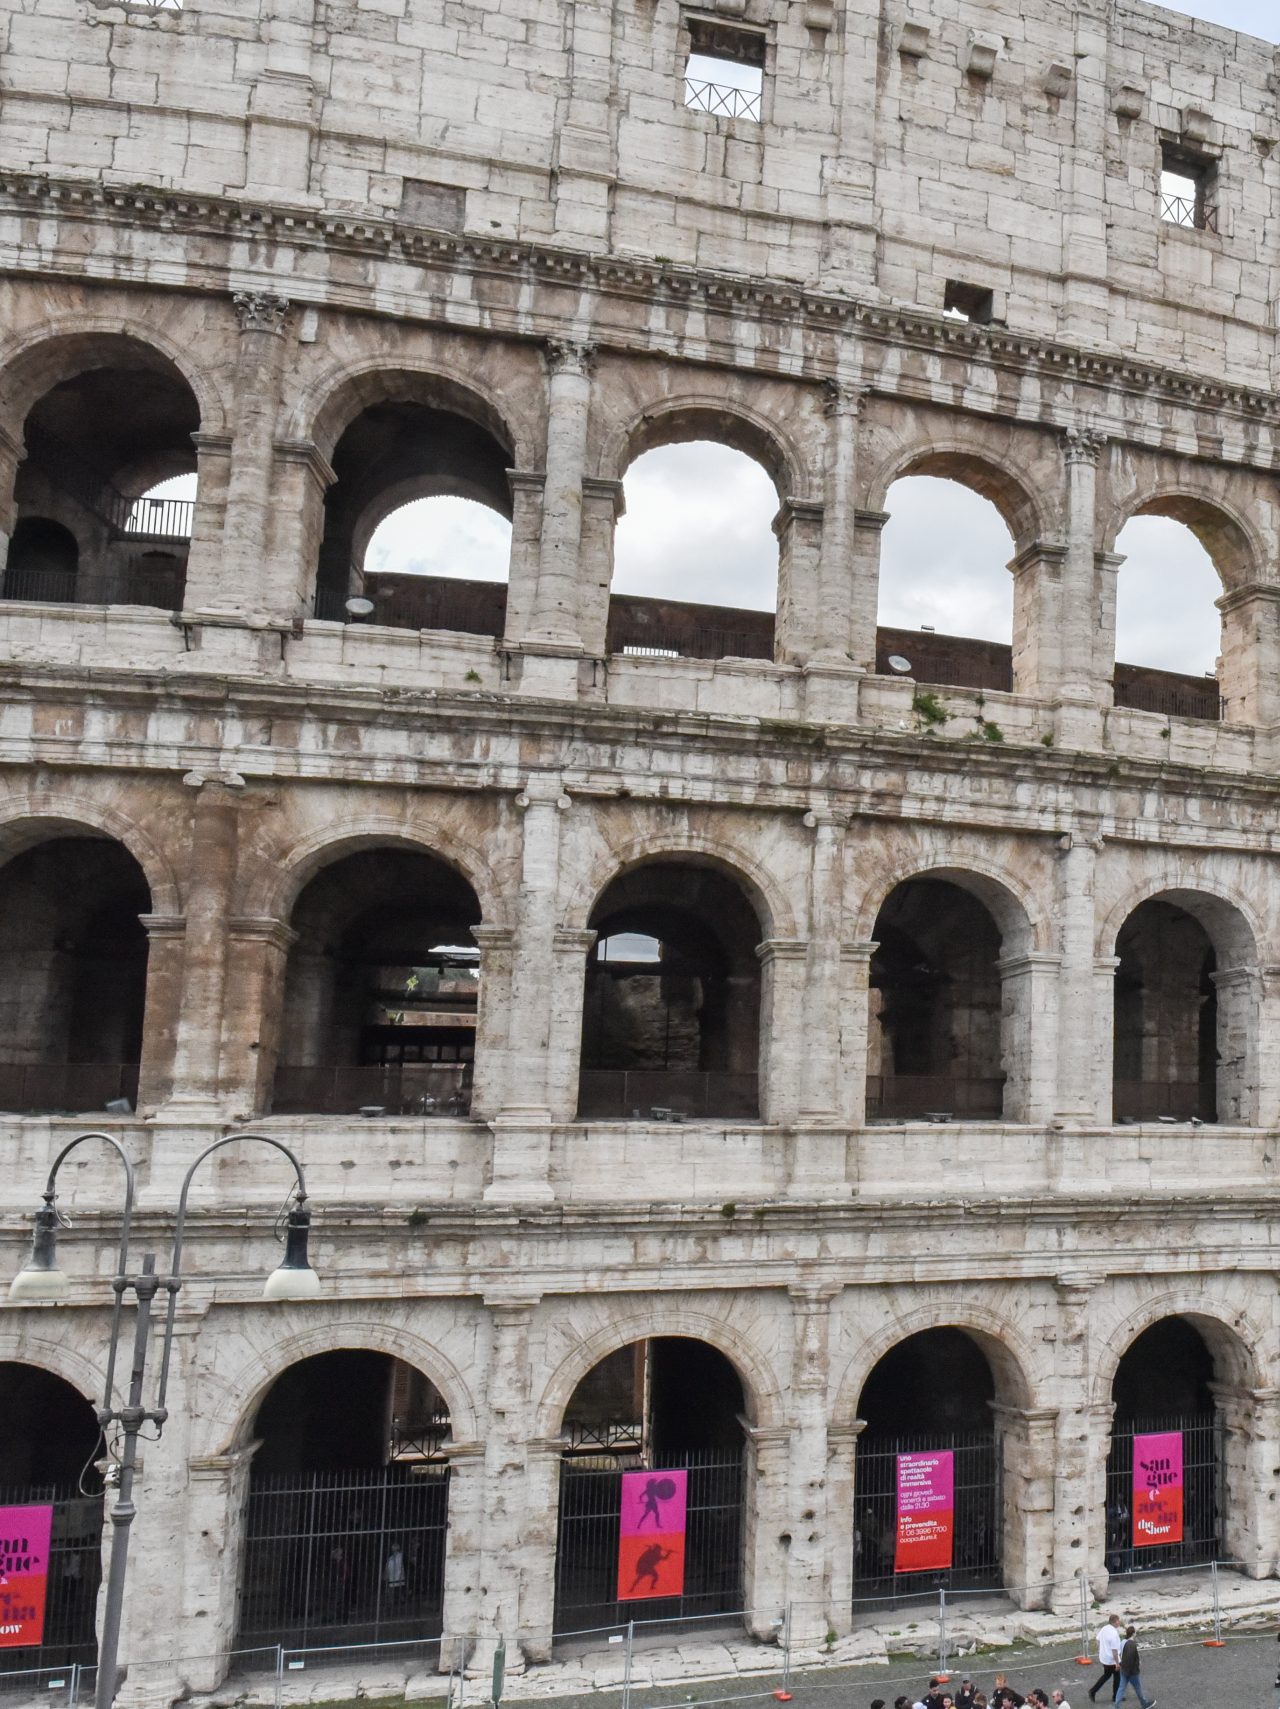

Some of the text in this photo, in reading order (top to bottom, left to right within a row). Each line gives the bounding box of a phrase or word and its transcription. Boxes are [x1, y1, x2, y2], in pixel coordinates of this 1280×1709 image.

[900, 1459, 939, 1468] straordinario
[900, 1466, 932, 1475] spettacolo
[900, 1480, 932, 1488] immersiva
[905, 1520, 938, 1530] prevendita
[0, 1624, 23, 1635] ow
